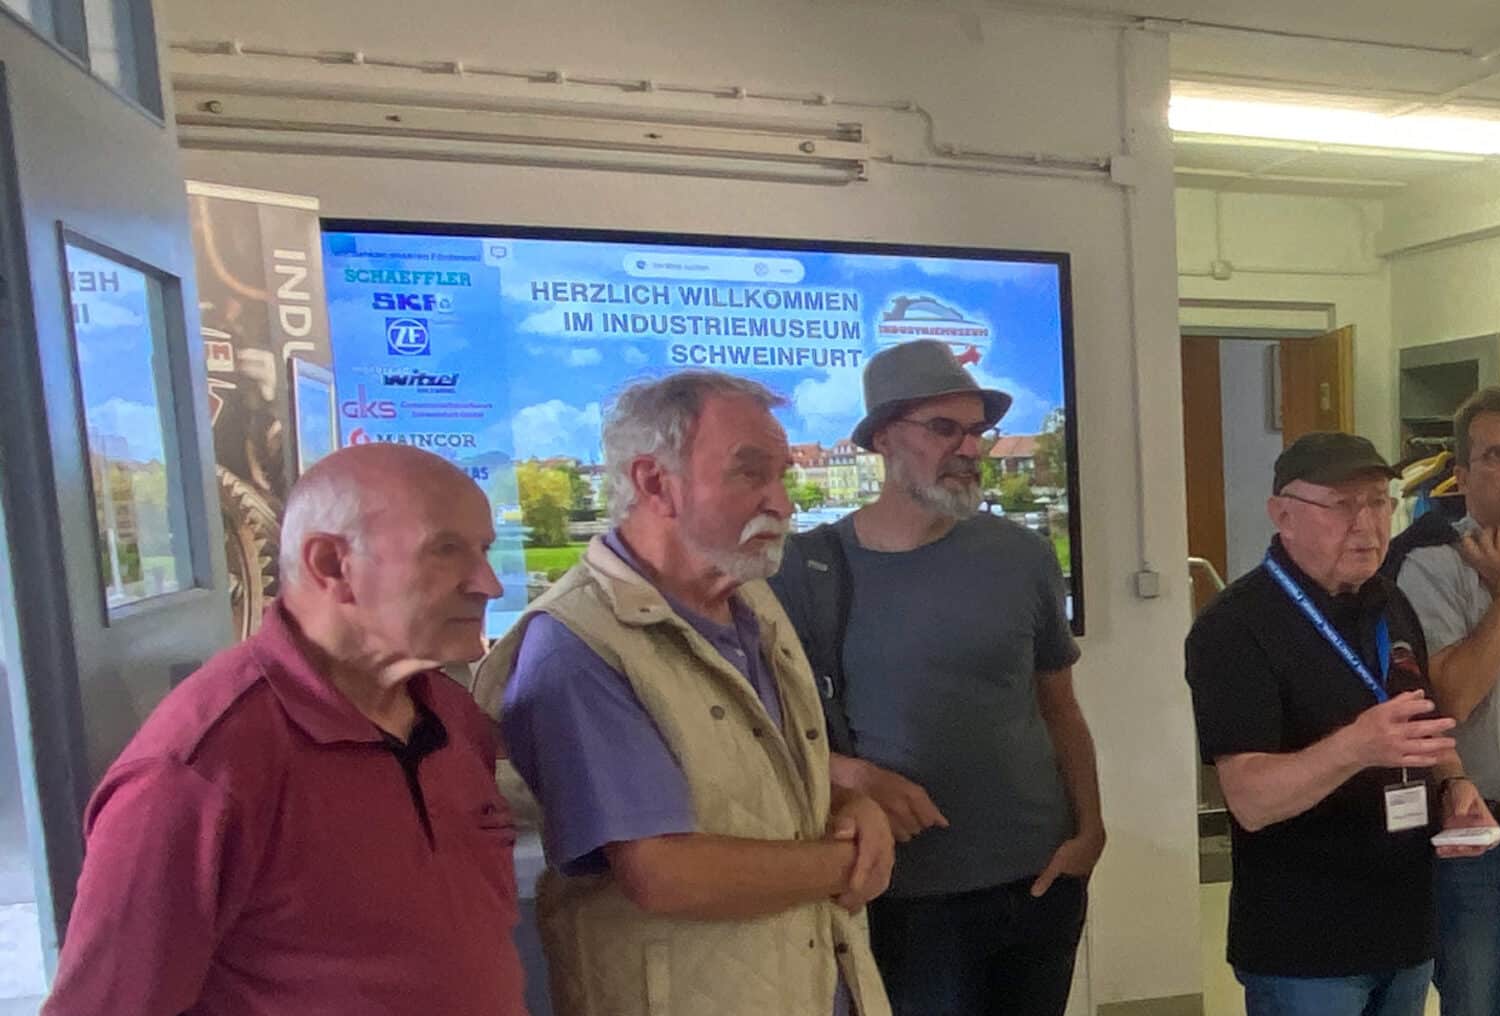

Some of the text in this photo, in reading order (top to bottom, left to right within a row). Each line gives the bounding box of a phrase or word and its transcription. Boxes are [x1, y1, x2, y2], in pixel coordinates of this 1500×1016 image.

[344, 268, 472, 287] SCHAEFFLER
[372, 292, 437, 311] SKF
[530, 281, 858, 313] HERZLICH WILLKOMMEN
[564, 311, 861, 340] IM INDUSTRIEMUSEUM
[671, 344, 862, 368] SCHWEINFURT
